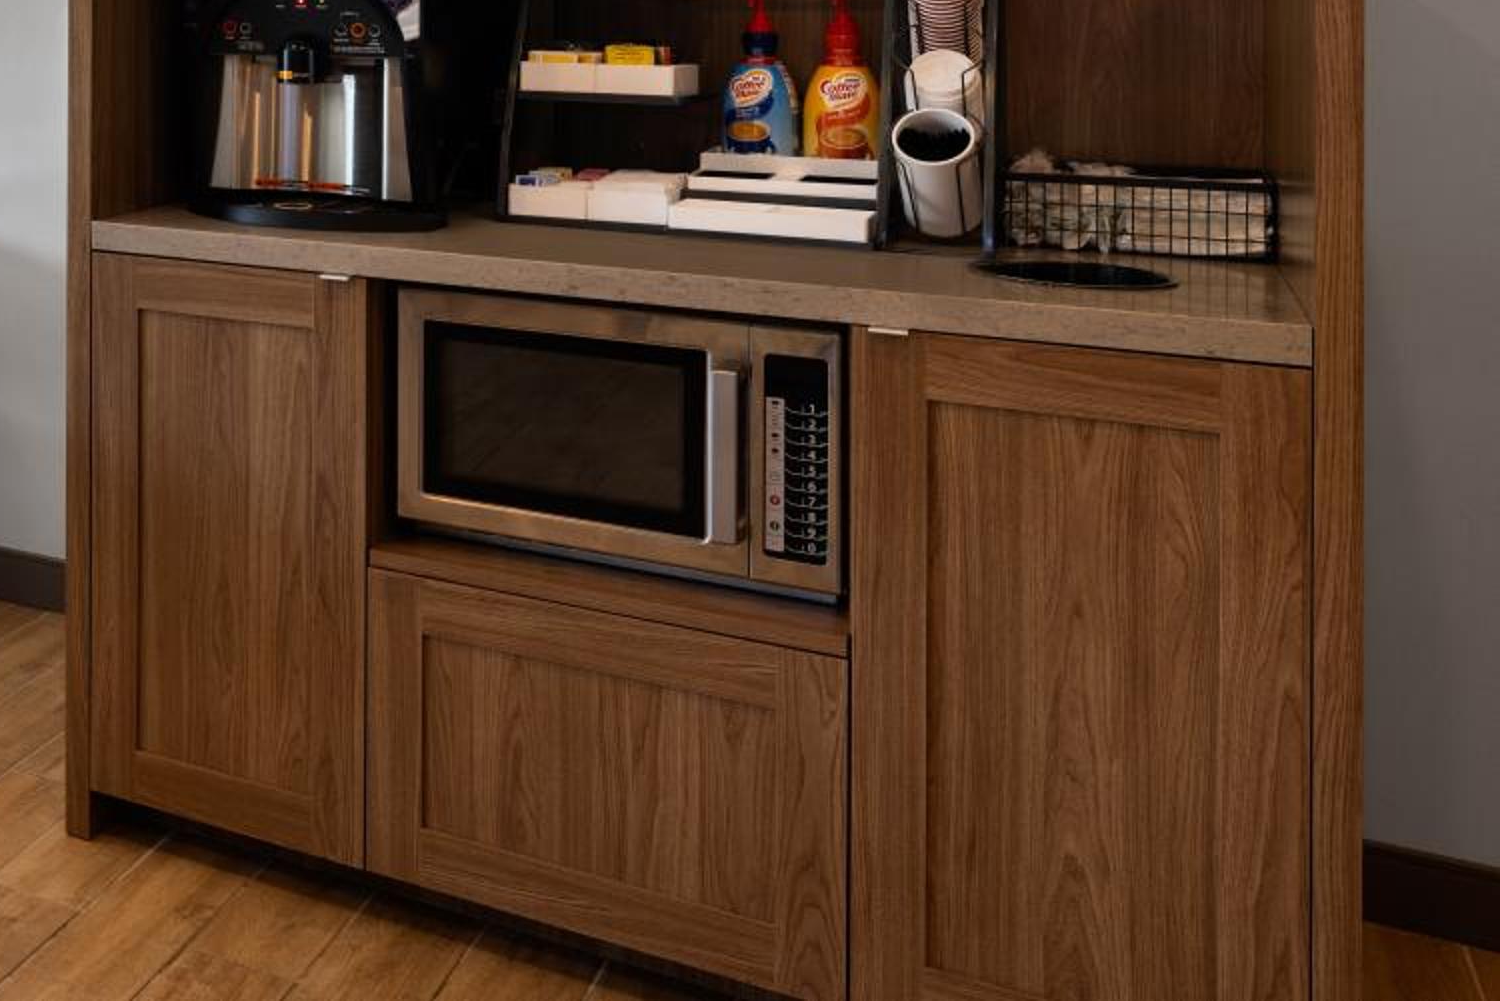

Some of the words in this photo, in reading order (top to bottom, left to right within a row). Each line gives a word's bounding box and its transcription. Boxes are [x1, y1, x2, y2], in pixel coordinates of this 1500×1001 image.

[807, 403, 816, 416] 1
[807, 418, 817, 431] 2
[807, 450, 817, 463] 4
[807, 481, 817, 493] 6
[807, 496, 817, 508] 7
